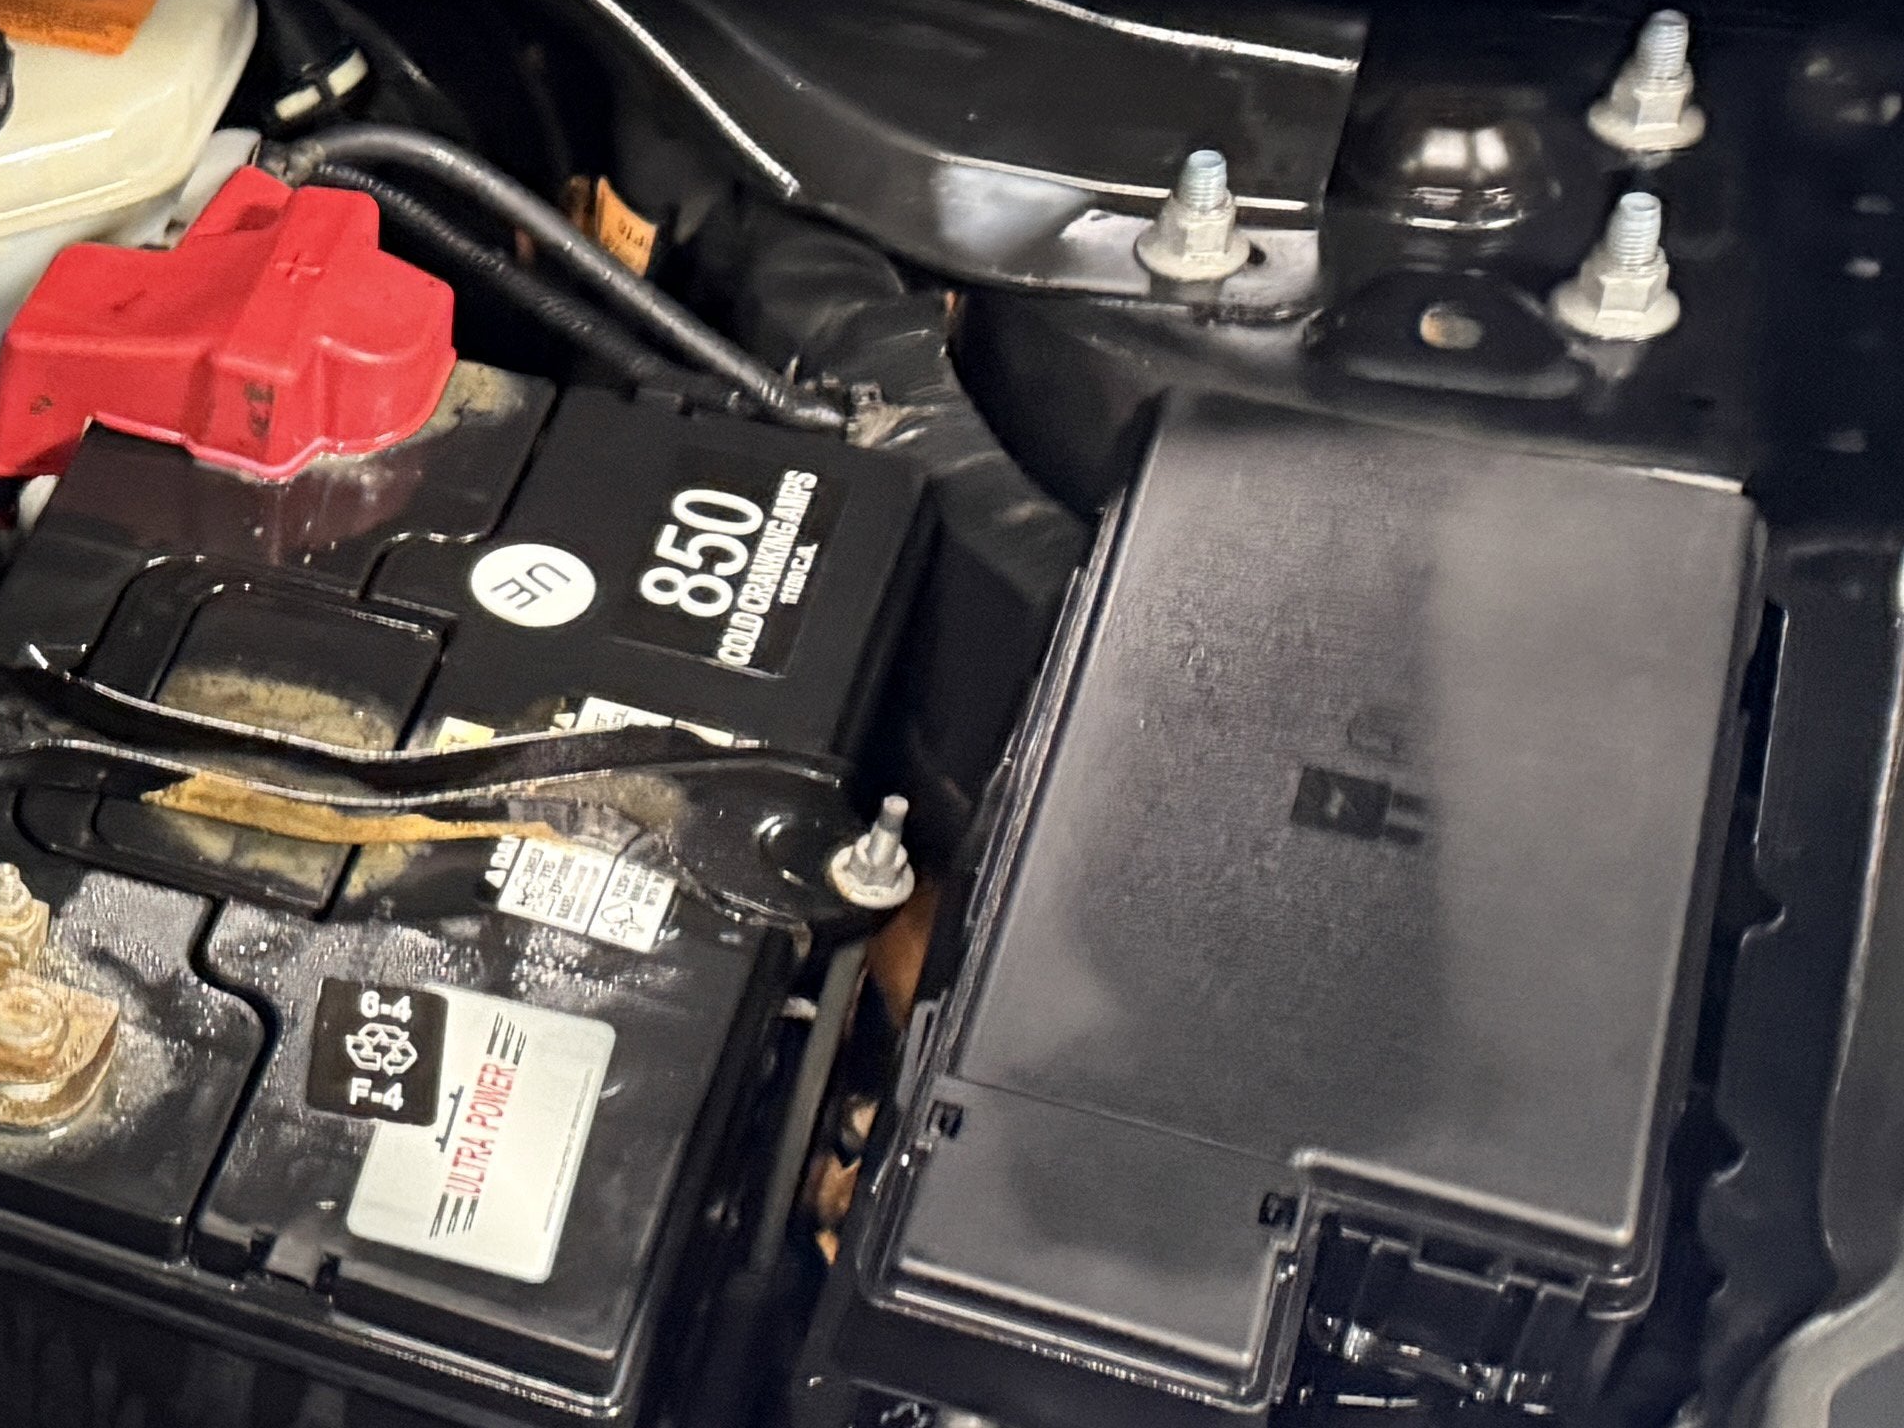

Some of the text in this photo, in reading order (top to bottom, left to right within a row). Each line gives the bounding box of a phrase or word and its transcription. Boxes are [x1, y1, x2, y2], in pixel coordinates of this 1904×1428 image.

[639, 488, 764, 618] 850
[717, 470, 818, 666] COLD CRANKING AMPS
[349, 1077, 404, 1112] F-4
[445, 1061, 517, 1197] ULTRA POWER
